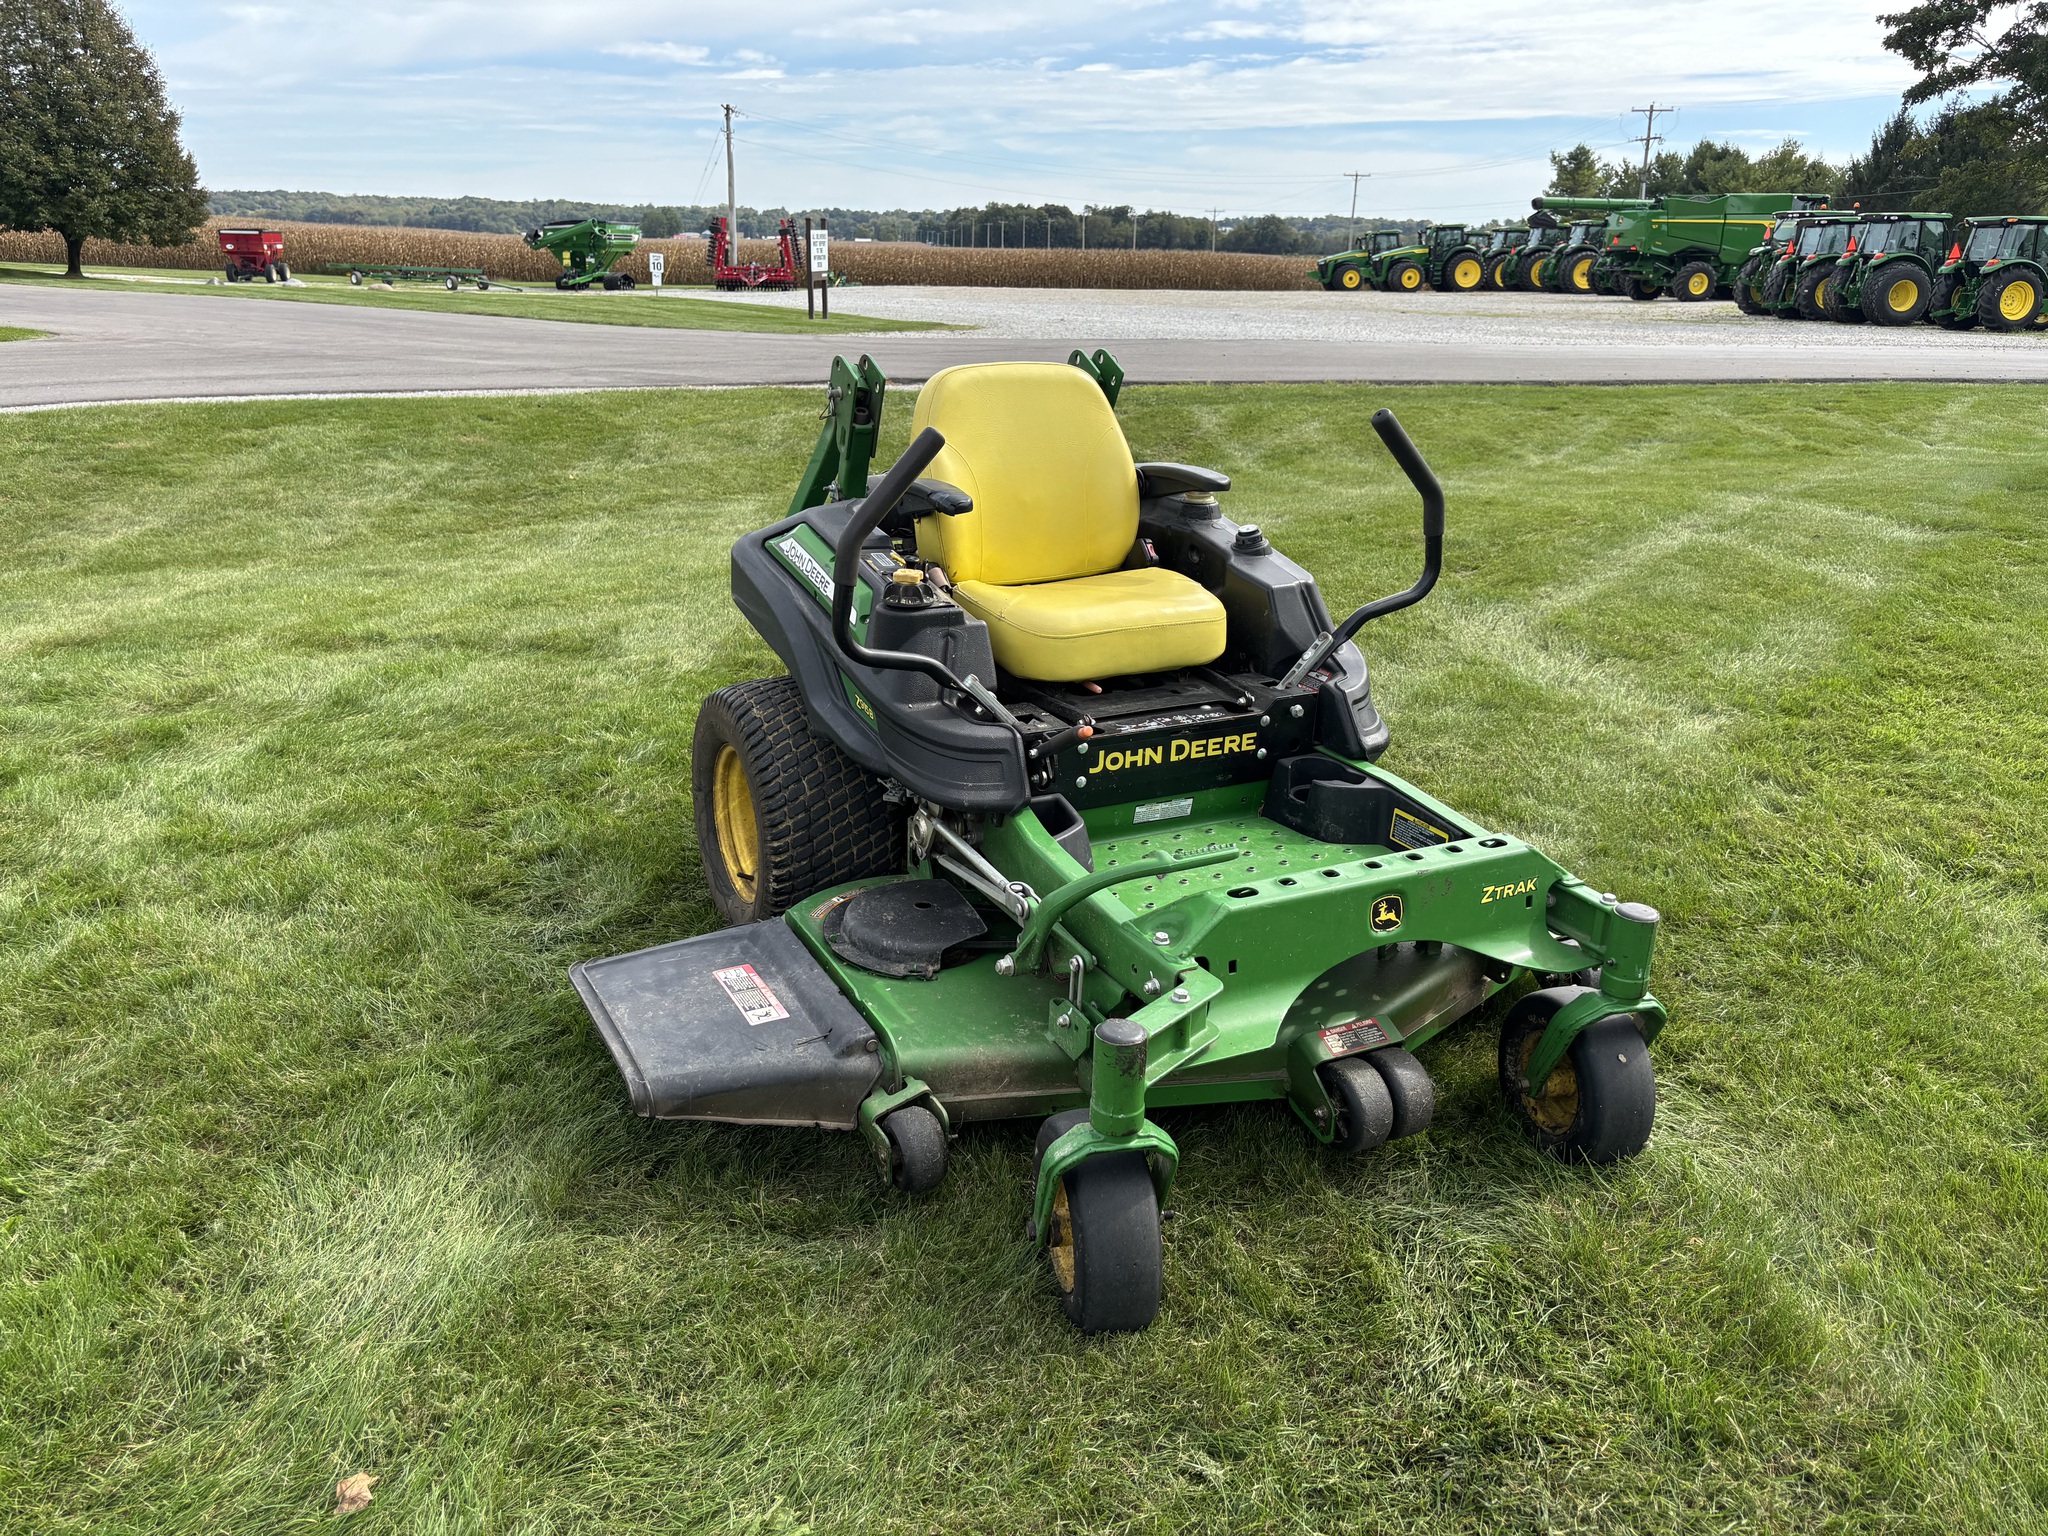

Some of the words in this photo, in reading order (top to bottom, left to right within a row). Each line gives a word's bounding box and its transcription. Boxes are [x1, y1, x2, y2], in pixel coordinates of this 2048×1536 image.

[652, 261, 662, 271] 10
[786, 541, 807, 570] JOHN
[804, 558, 831, 594] DEERE
[1089, 745, 1163, 774] JOHN
[1170, 732, 1258, 762] DEERE
[1480, 877, 1538, 904] ZTRAK
